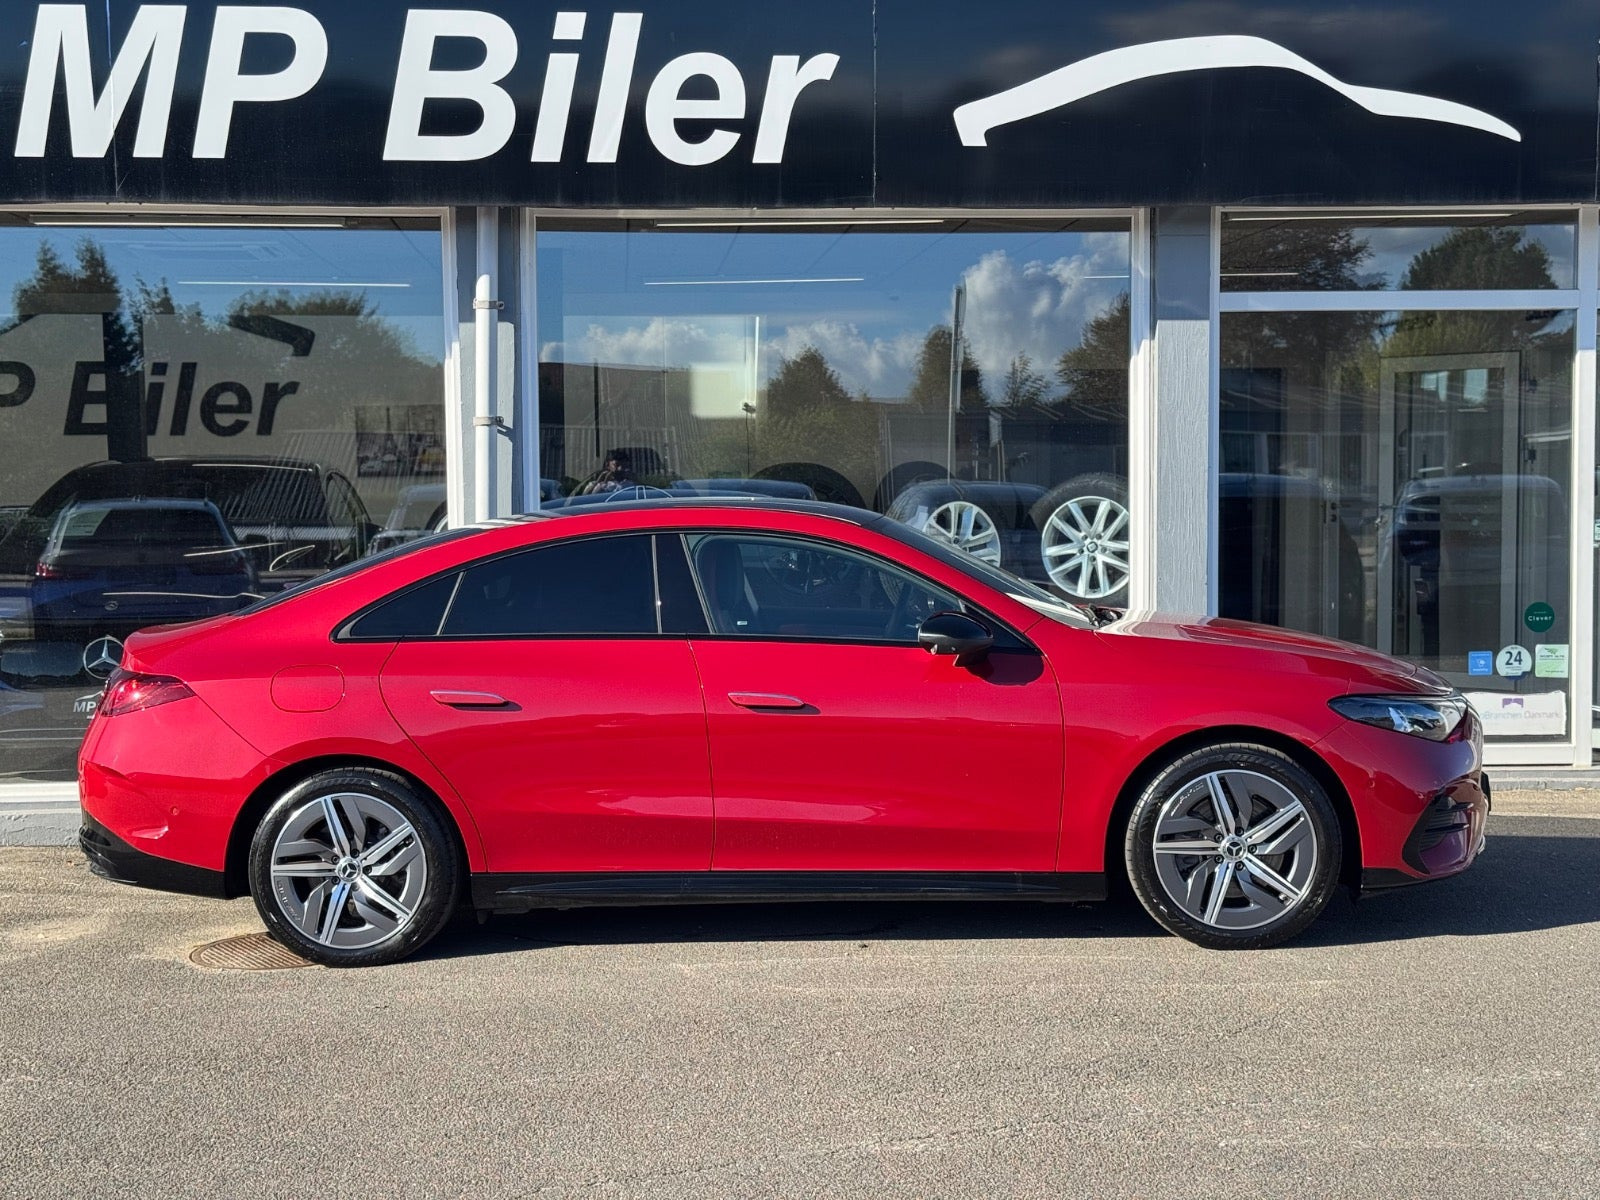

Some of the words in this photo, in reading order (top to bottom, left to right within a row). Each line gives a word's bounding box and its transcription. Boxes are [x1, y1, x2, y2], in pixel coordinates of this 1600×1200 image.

[14, 4, 329, 160] MP
[382, 8, 840, 166] Biler
[1504, 650, 1523, 666] 24
[73, 701, 96, 713] MP
